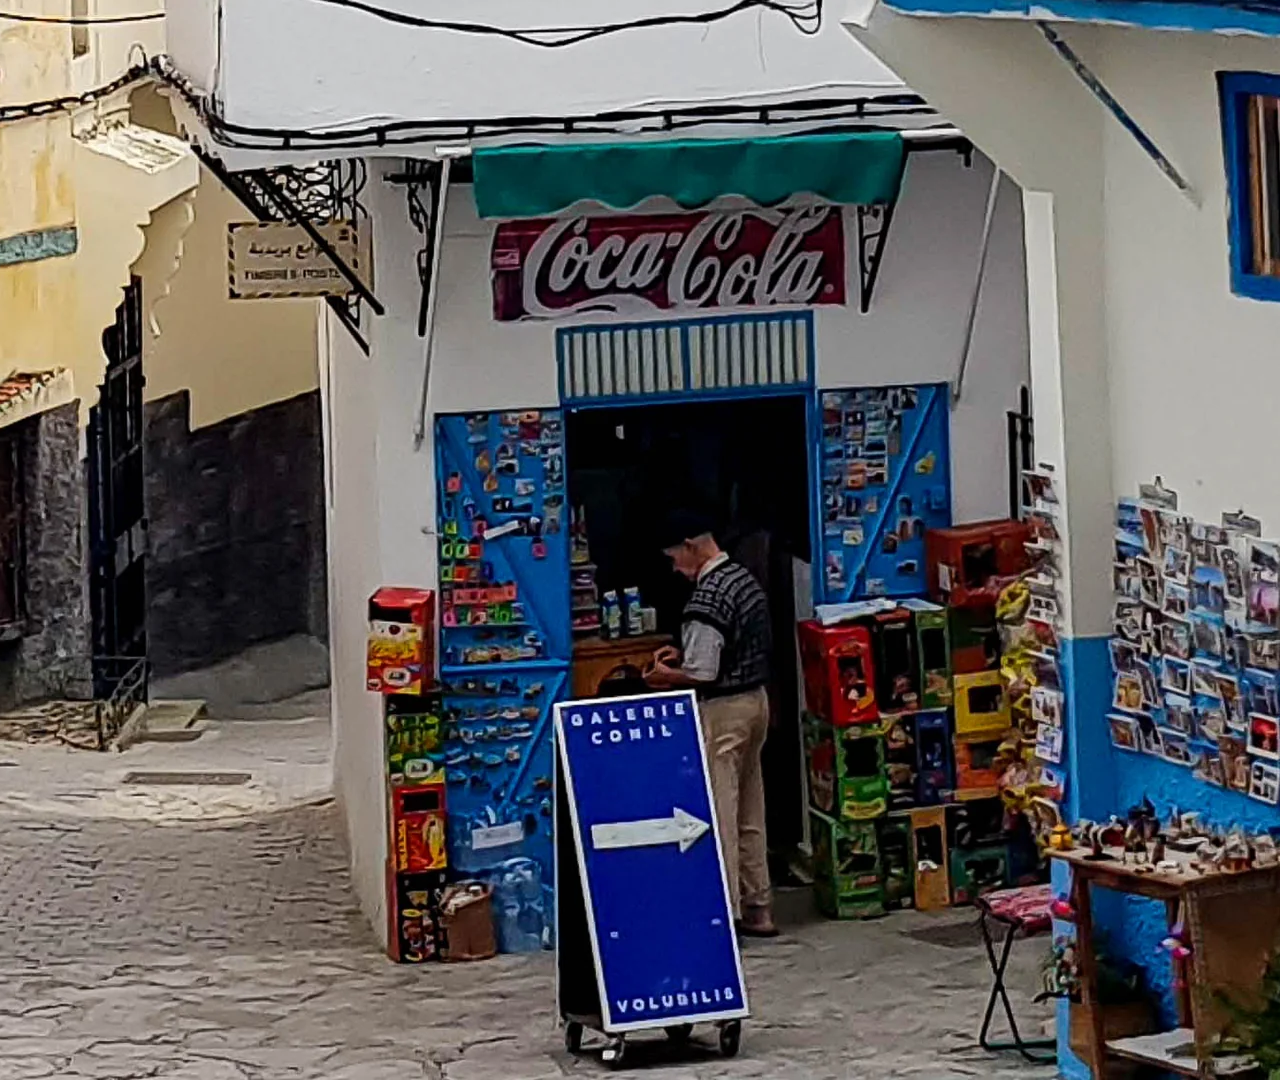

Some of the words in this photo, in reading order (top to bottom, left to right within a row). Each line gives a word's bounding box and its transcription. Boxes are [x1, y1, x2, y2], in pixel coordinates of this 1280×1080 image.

[523, 205, 829, 318] Coca-Cola
[570, 702, 686, 727] GALERIE
[591, 723, 672, 745] CONIL
[616, 986, 735, 1014] VOLUBILIS
